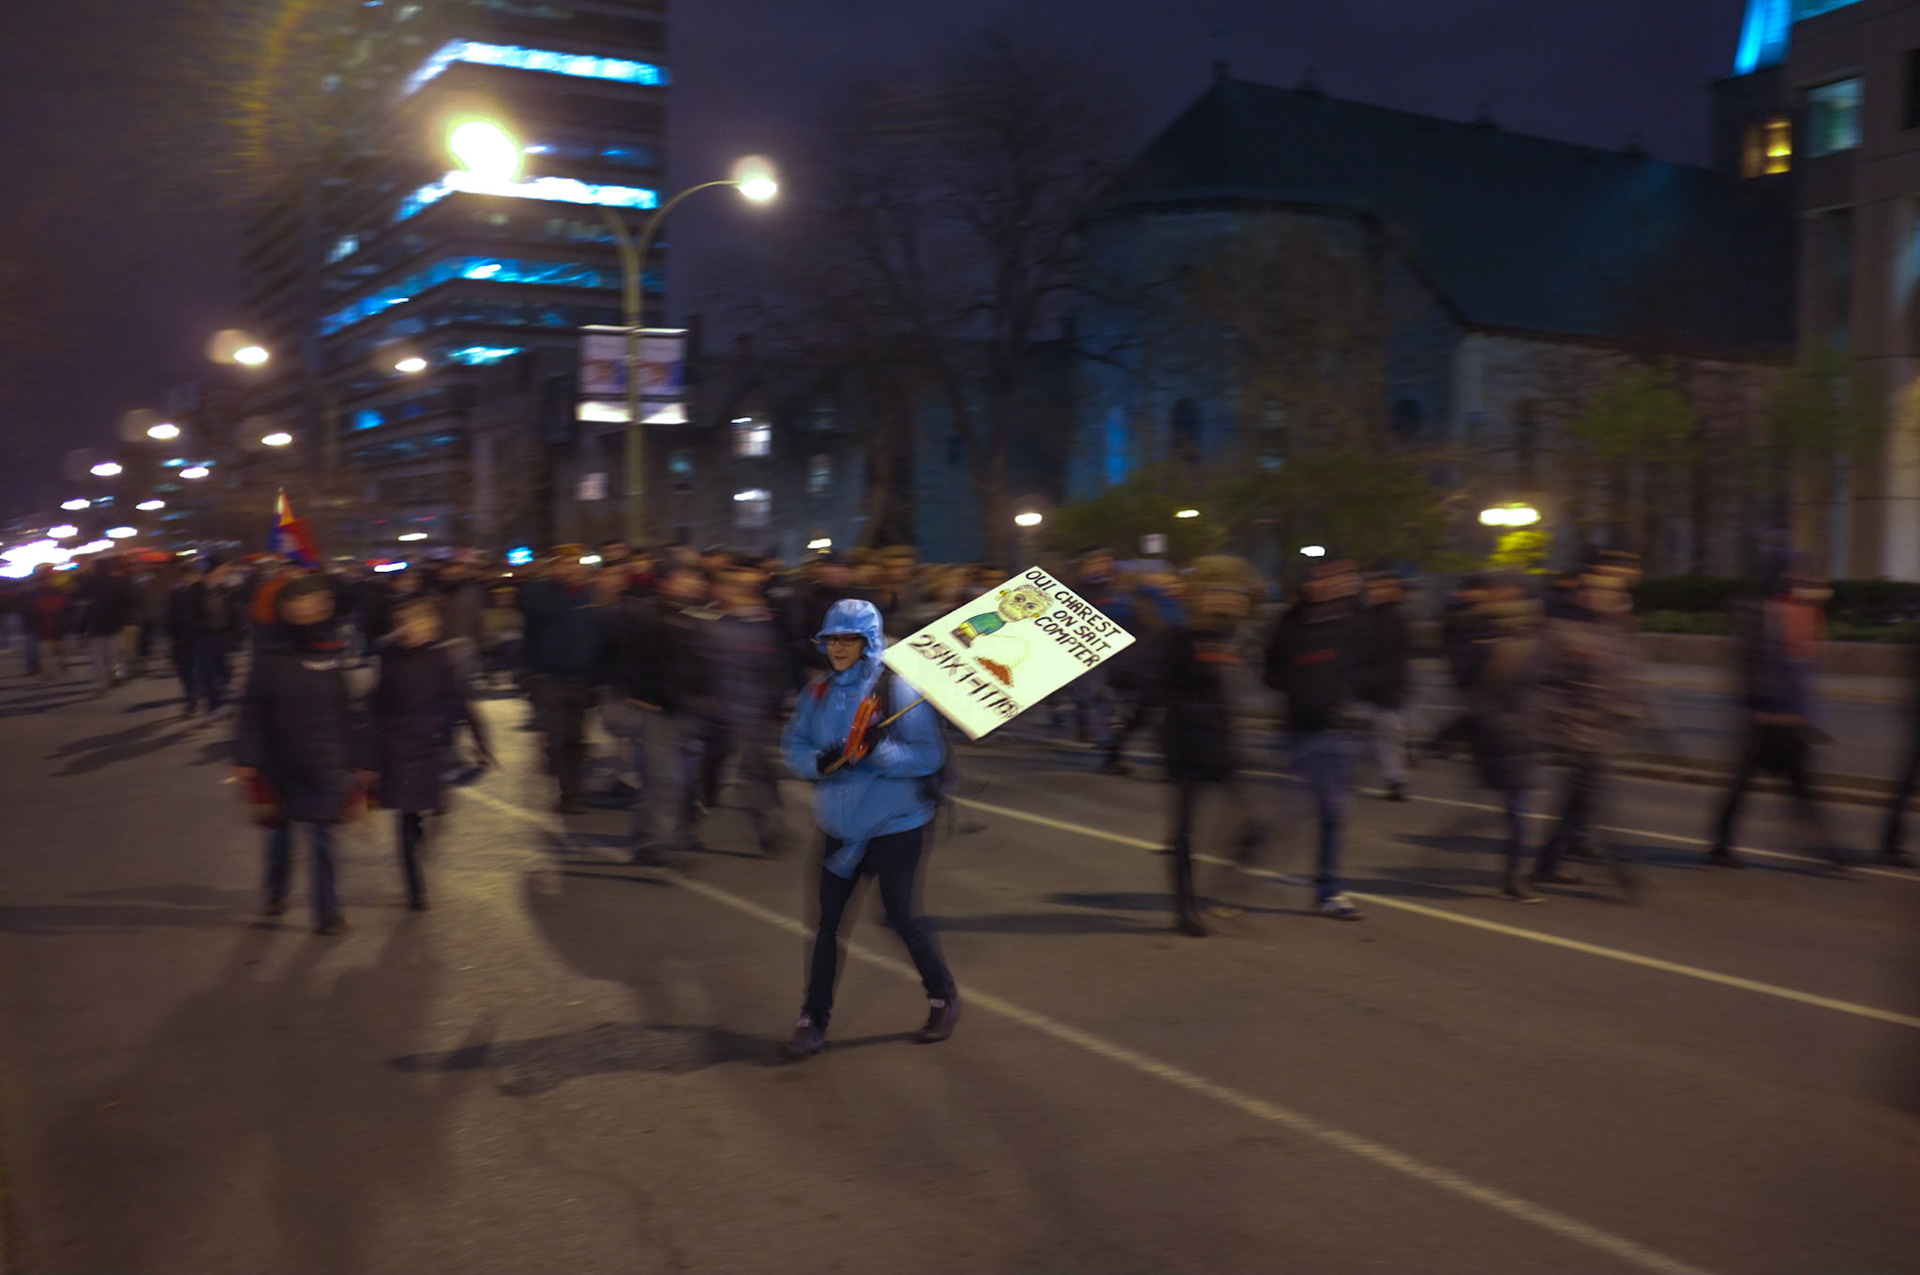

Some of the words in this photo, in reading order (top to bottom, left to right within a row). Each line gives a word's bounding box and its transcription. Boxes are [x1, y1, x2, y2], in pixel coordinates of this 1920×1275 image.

[1025, 571, 1056, 591] OUI
[1054, 591, 1121, 637] CHAREST
[1034, 616, 1100, 667] COMPTER
[1053, 610, 1078, 627] ON
[1073, 625, 1111, 652] SAIT
